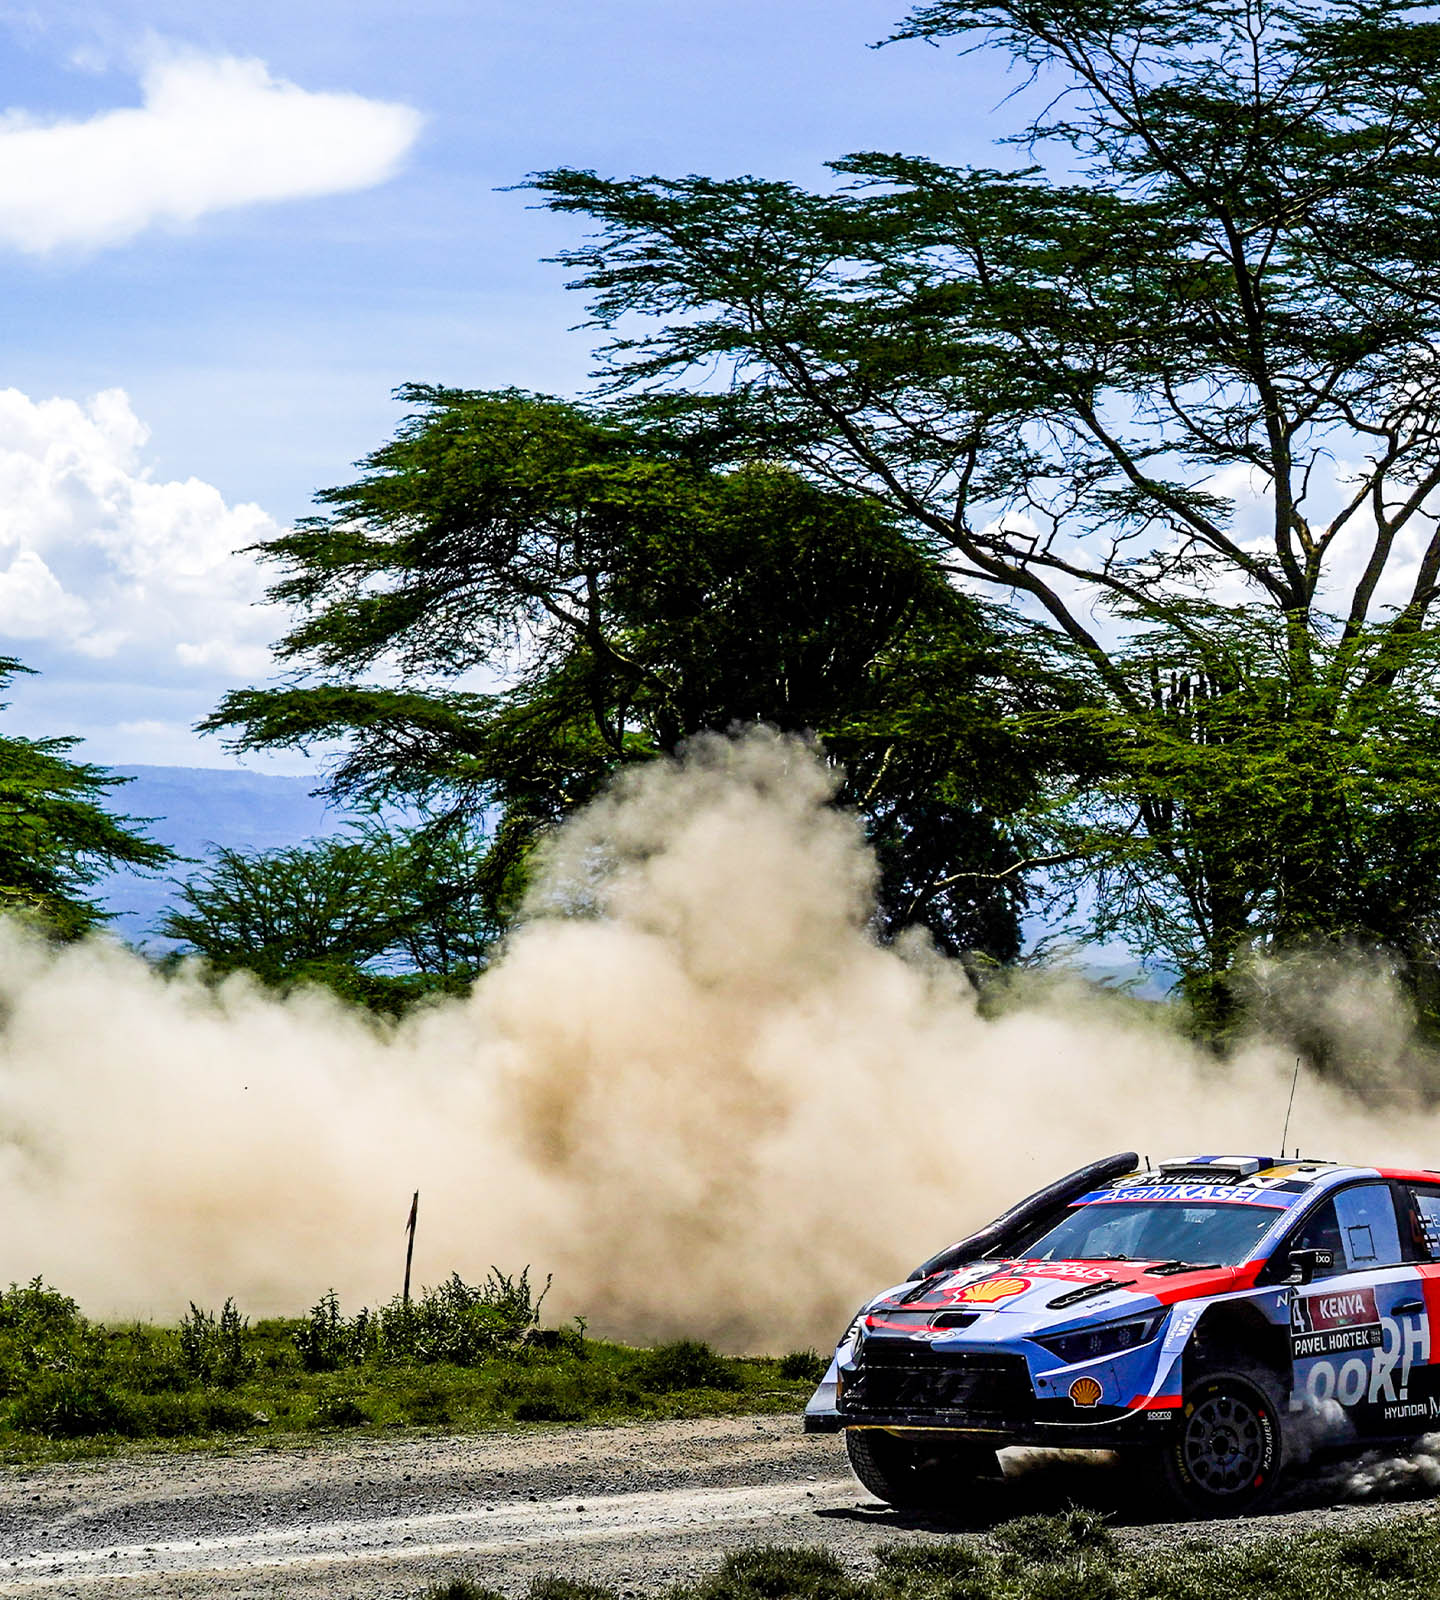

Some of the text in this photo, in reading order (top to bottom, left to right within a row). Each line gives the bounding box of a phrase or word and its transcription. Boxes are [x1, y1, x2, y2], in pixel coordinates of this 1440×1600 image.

[1148, 1176, 1236, 1185] HYUNDAI
[1315, 1251, 1331, 1263] ixo
[1000, 1265, 1118, 1280] MOBIS
[1276, 1292, 1289, 1307] N
[1320, 1294, 1366, 1319] KENYA
[1292, 1299, 1305, 1333] 4
[1295, 1330, 1370, 1356] PAVEL HORTEK
[1384, 1403, 1428, 1419] HYUNDAI
